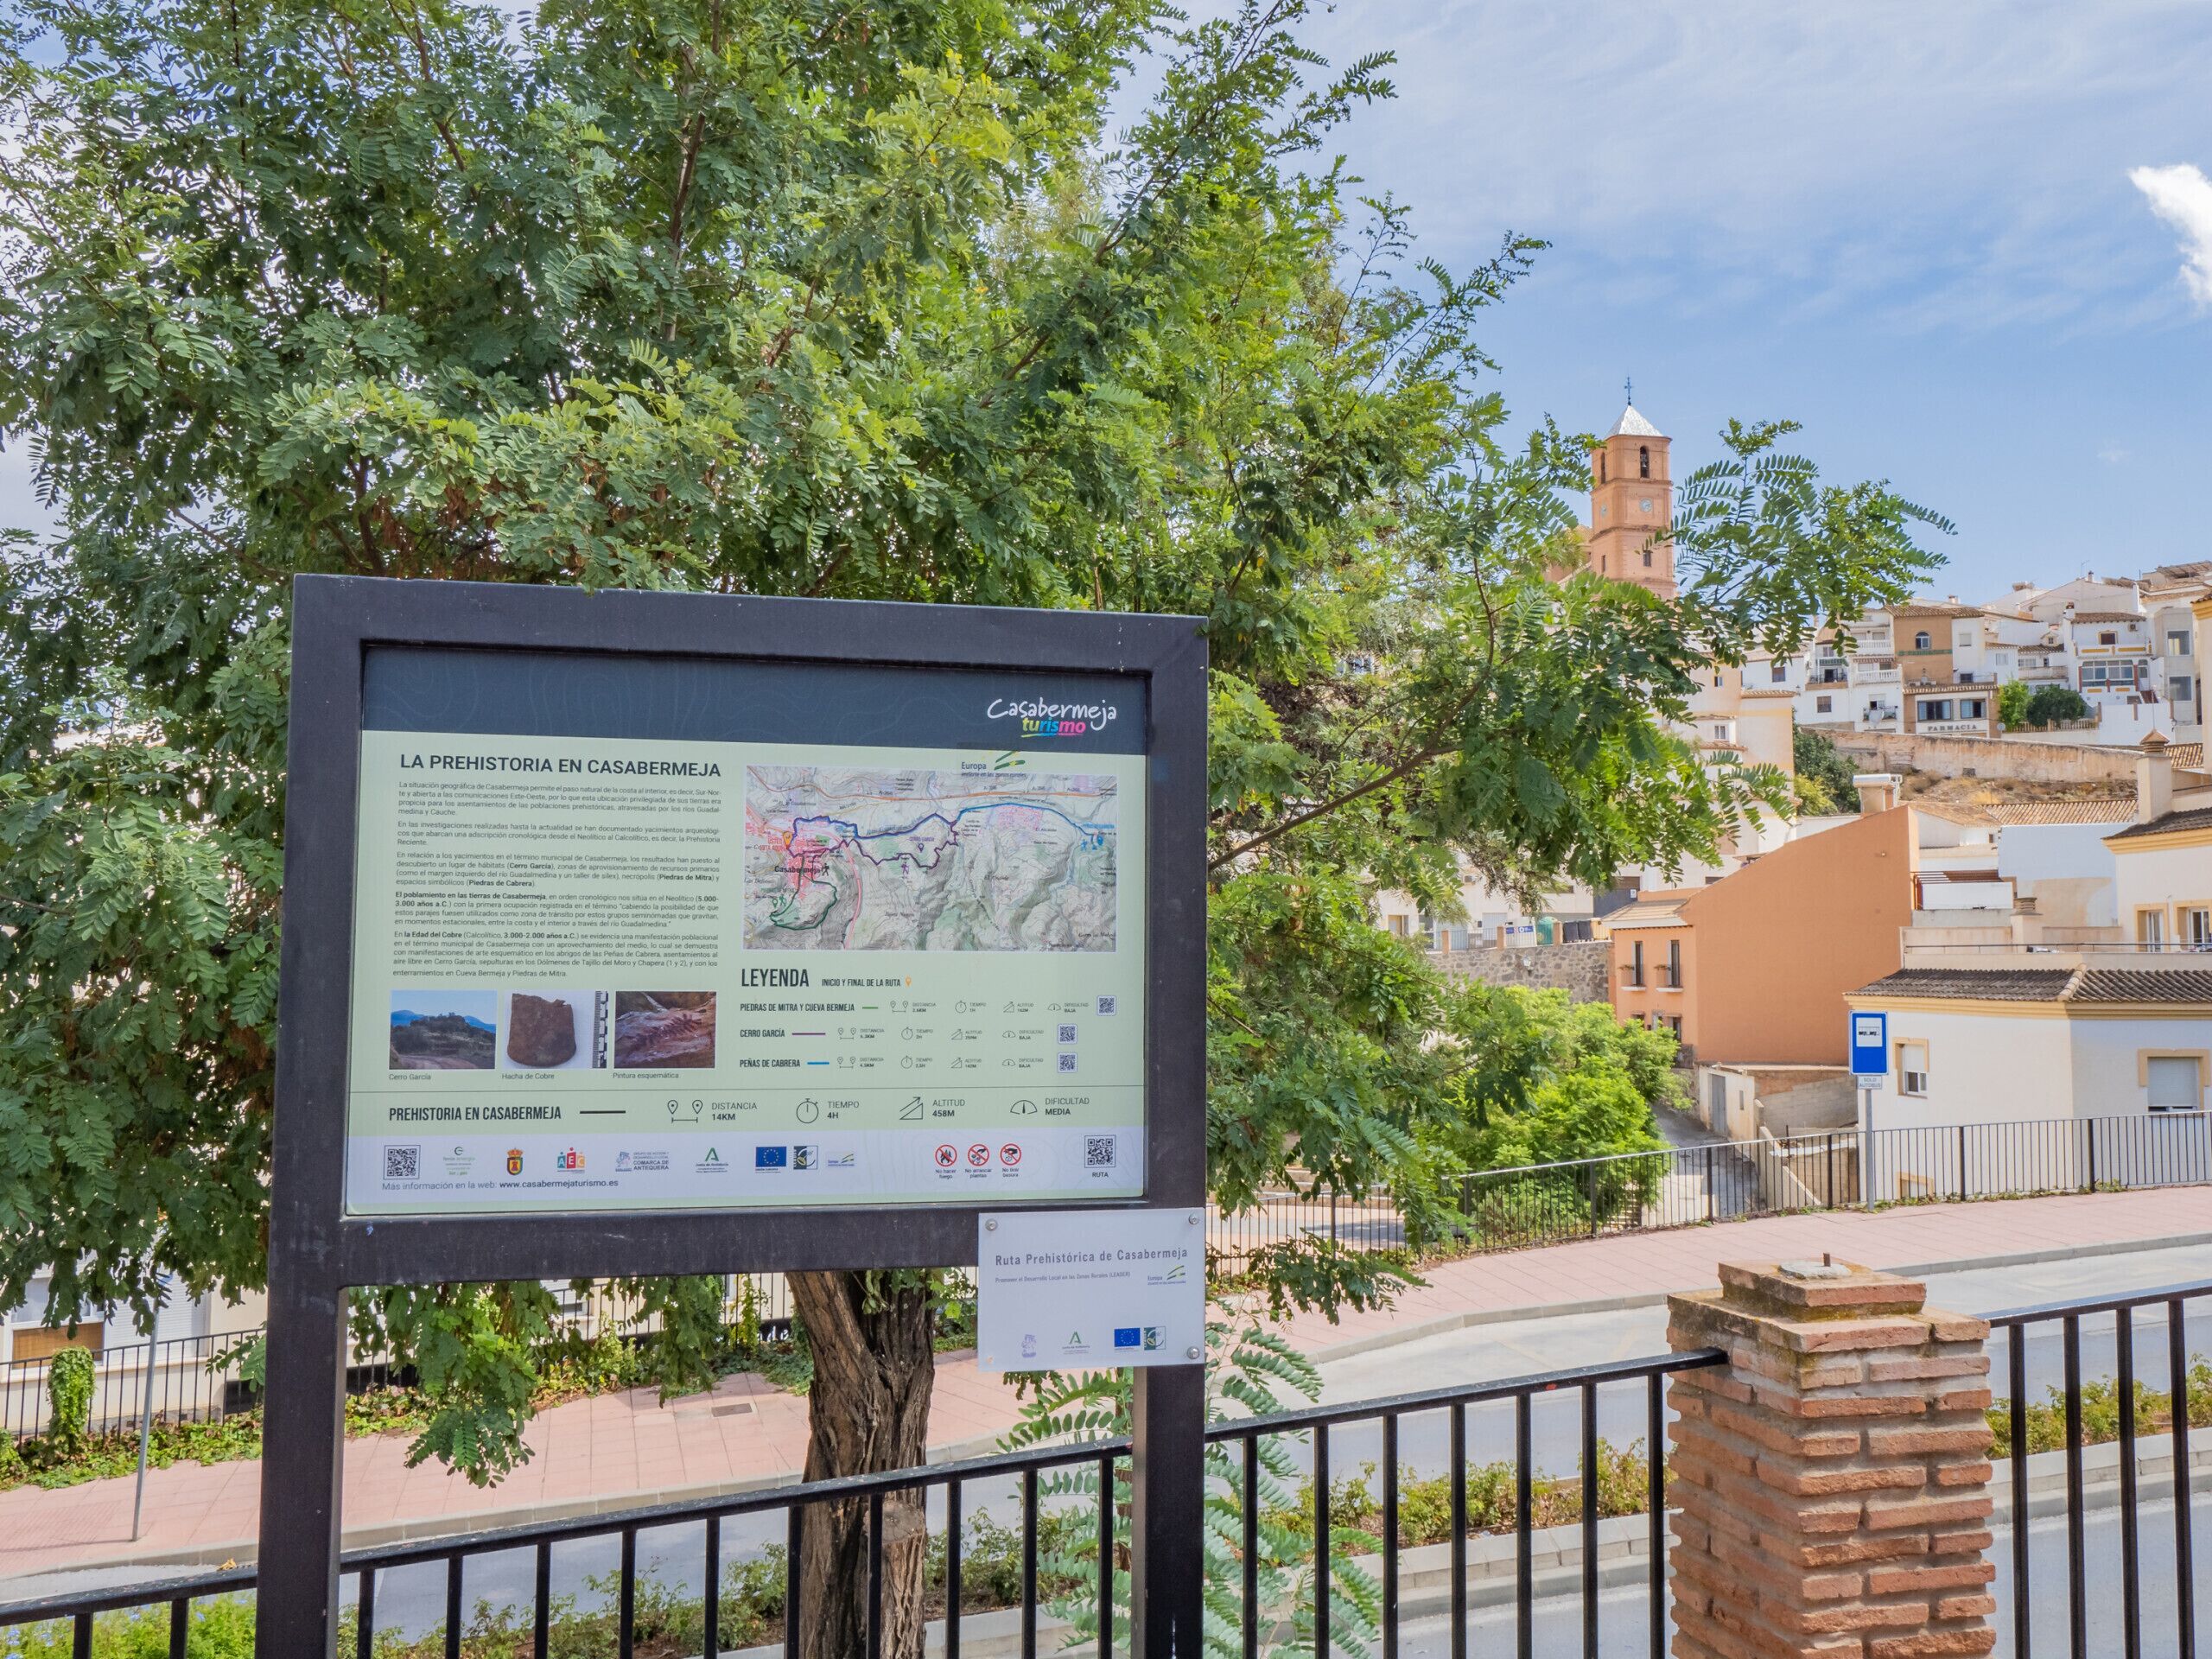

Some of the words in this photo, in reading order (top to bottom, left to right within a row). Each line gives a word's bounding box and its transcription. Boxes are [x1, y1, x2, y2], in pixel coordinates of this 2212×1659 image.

[987, 696, 1117, 731] Casabermeja
[1021, 717, 1086, 734] turismo
[400, 753, 423, 769] LA
[429, 754, 552, 772] PREHISTORIA
[558, 759, 582, 772] EN
[587, 759, 721, 777] CASABERMEJA
[961, 761, 987, 770] Europa
[741, 968, 809, 987] LEYENDA
[866, 978, 874, 987] DE
[885, 978, 900, 987] RUTA
[761, 1027, 785, 1037] GARCÍA
[739, 1058, 760, 1067] PEÑAS
[771, 1058, 800, 1067] CABRERA
[932, 1098, 965, 1107] ALTITUD
[1045, 1096, 1090, 1105] DIFICULTAD
[711, 1102, 757, 1110] DISTANCIA
[389, 1107, 461, 1121] PREHISTORIA
[465, 1107, 480, 1120] EN
[482, 1106, 561, 1120] CASABERMEJA
[403, 1181, 453, 1190] información
[499, 1179, 619, 1189] www.casabermejaturismo.es
[995, 1254, 1020, 1266] Ruta
[1026, 1250, 1094, 1264] Prehistórica
[1099, 1250, 1112, 1261] de
[1116, 1247, 1187, 1262] Casabermeja
